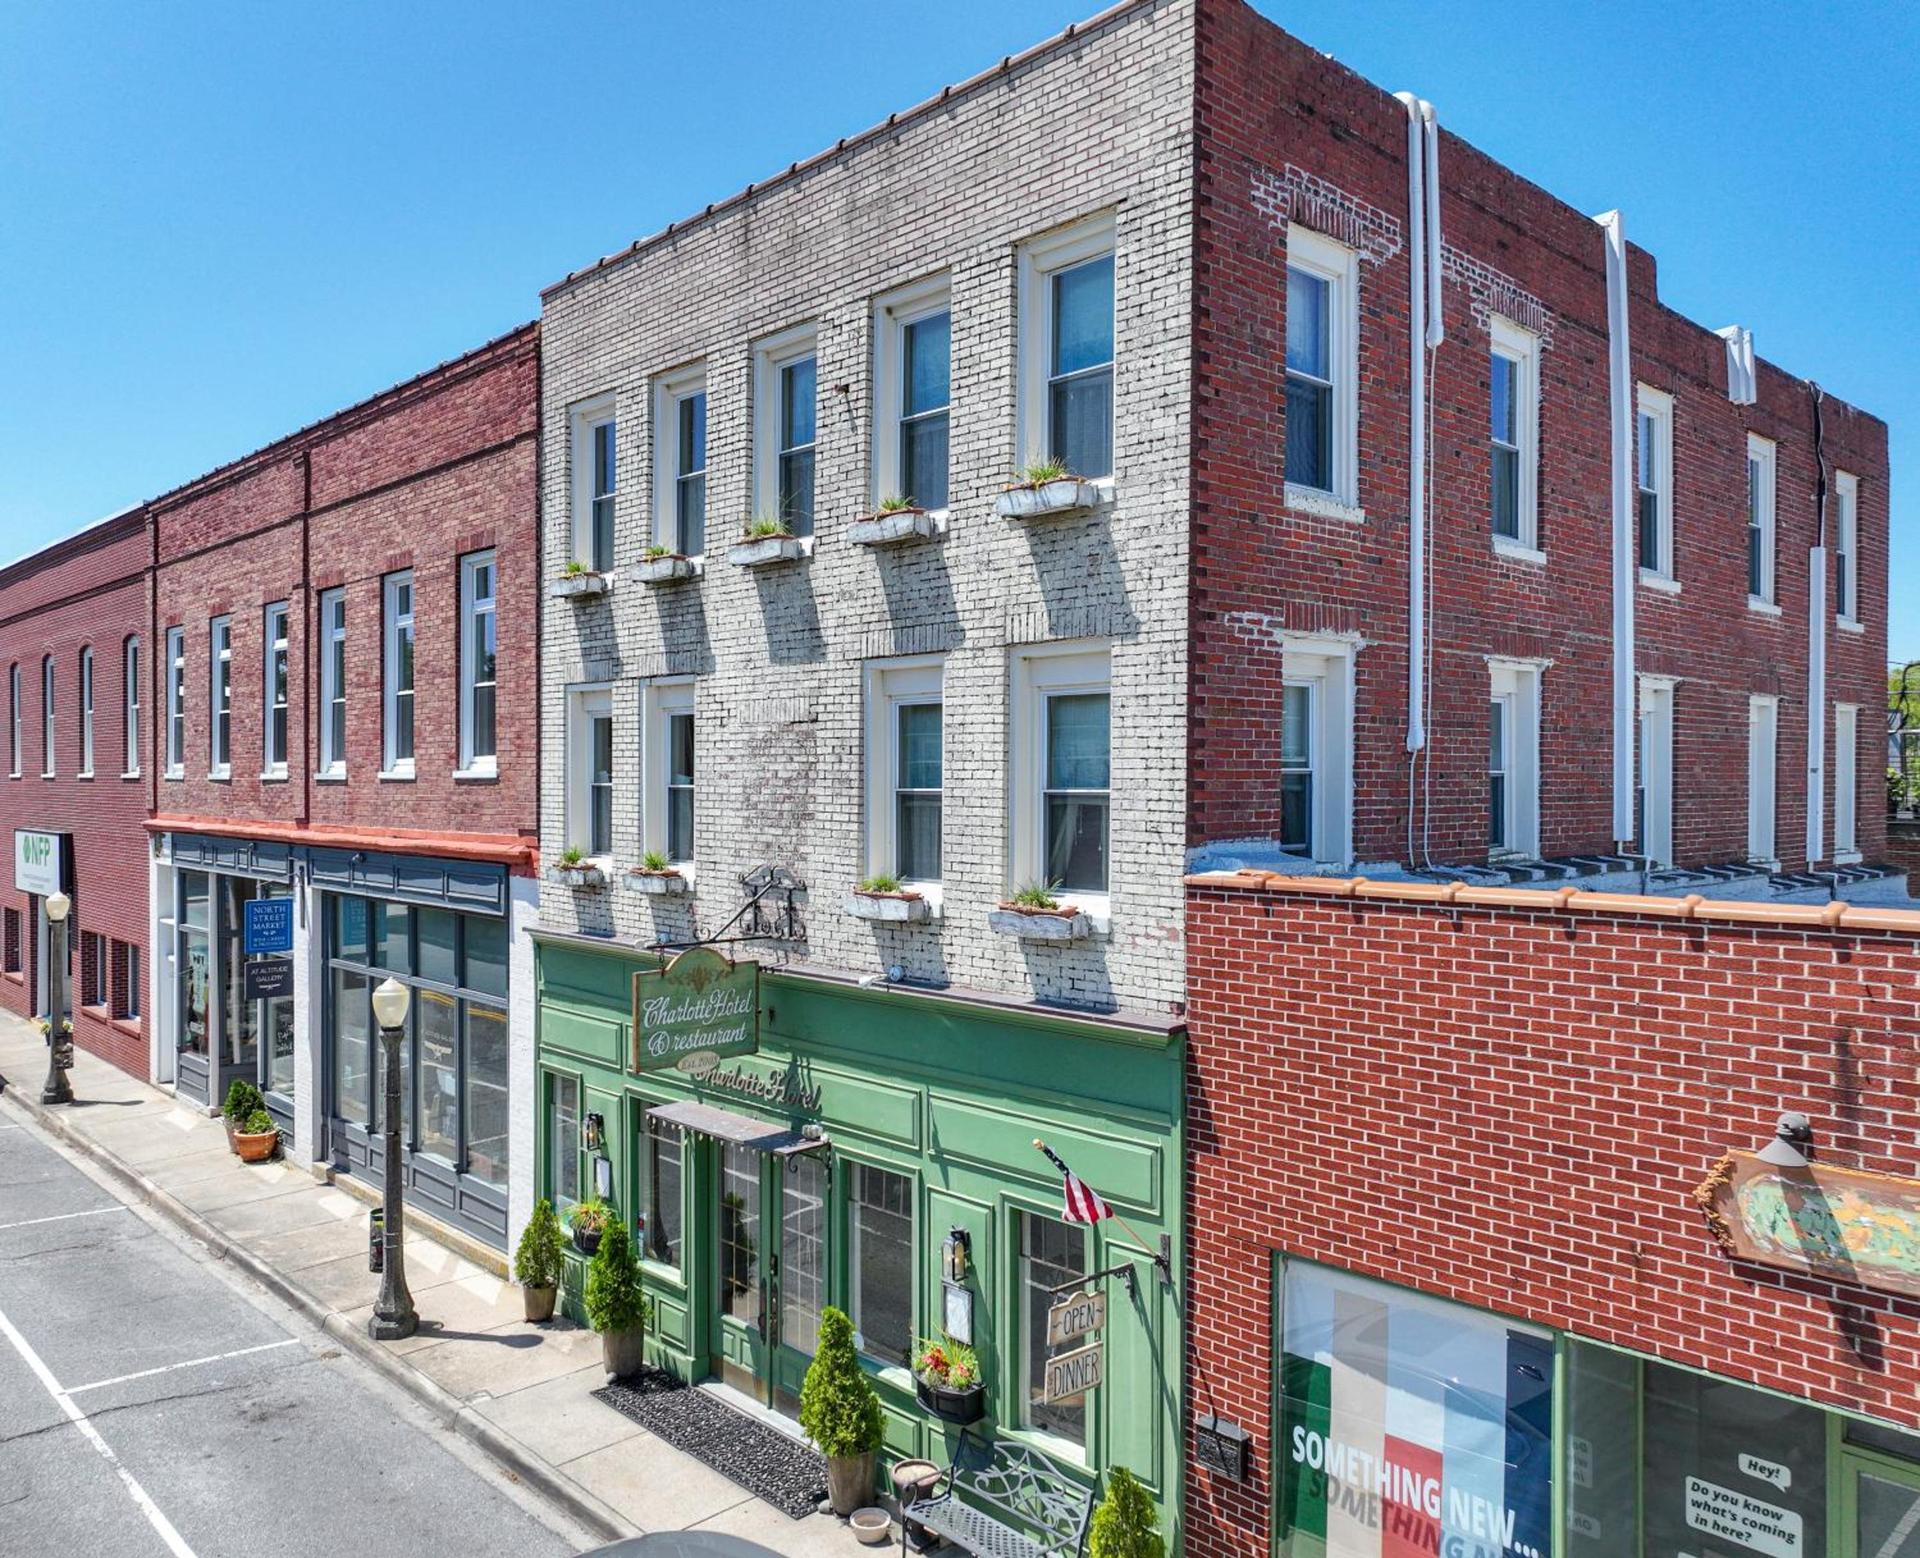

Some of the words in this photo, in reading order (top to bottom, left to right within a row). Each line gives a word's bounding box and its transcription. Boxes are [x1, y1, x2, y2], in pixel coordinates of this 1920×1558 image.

[31, 835, 50, 867] NFP
[252, 921, 286, 930] MARKET
[253, 905, 286, 914] NORTH
[253, 913, 286, 922] STREET
[643, 996, 712, 1028] Charlotte
[703, 989, 752, 1025] Hotel
[673, 1022, 747, 1051] restaurant
[1063, 1301, 1096, 1335] OPEN
[1053, 1352, 1099, 1397] DINNER
[1747, 1459, 1780, 1479] Hey!
[1292, 1425, 1441, 1519] SOMETHING
[1448, 1486, 1540, 1558] NEW...
[1690, 1481, 1709, 1496] Do
[1712, 1490, 1739, 1506] you
[1742, 1499, 1784, 1521] know
[1690, 1498, 1738, 1521] what's
[1741, 1516, 1796, 1545] coming
[1694, 1513, 1709, 1527] in
[1711, 1519, 1753, 1543] here?
